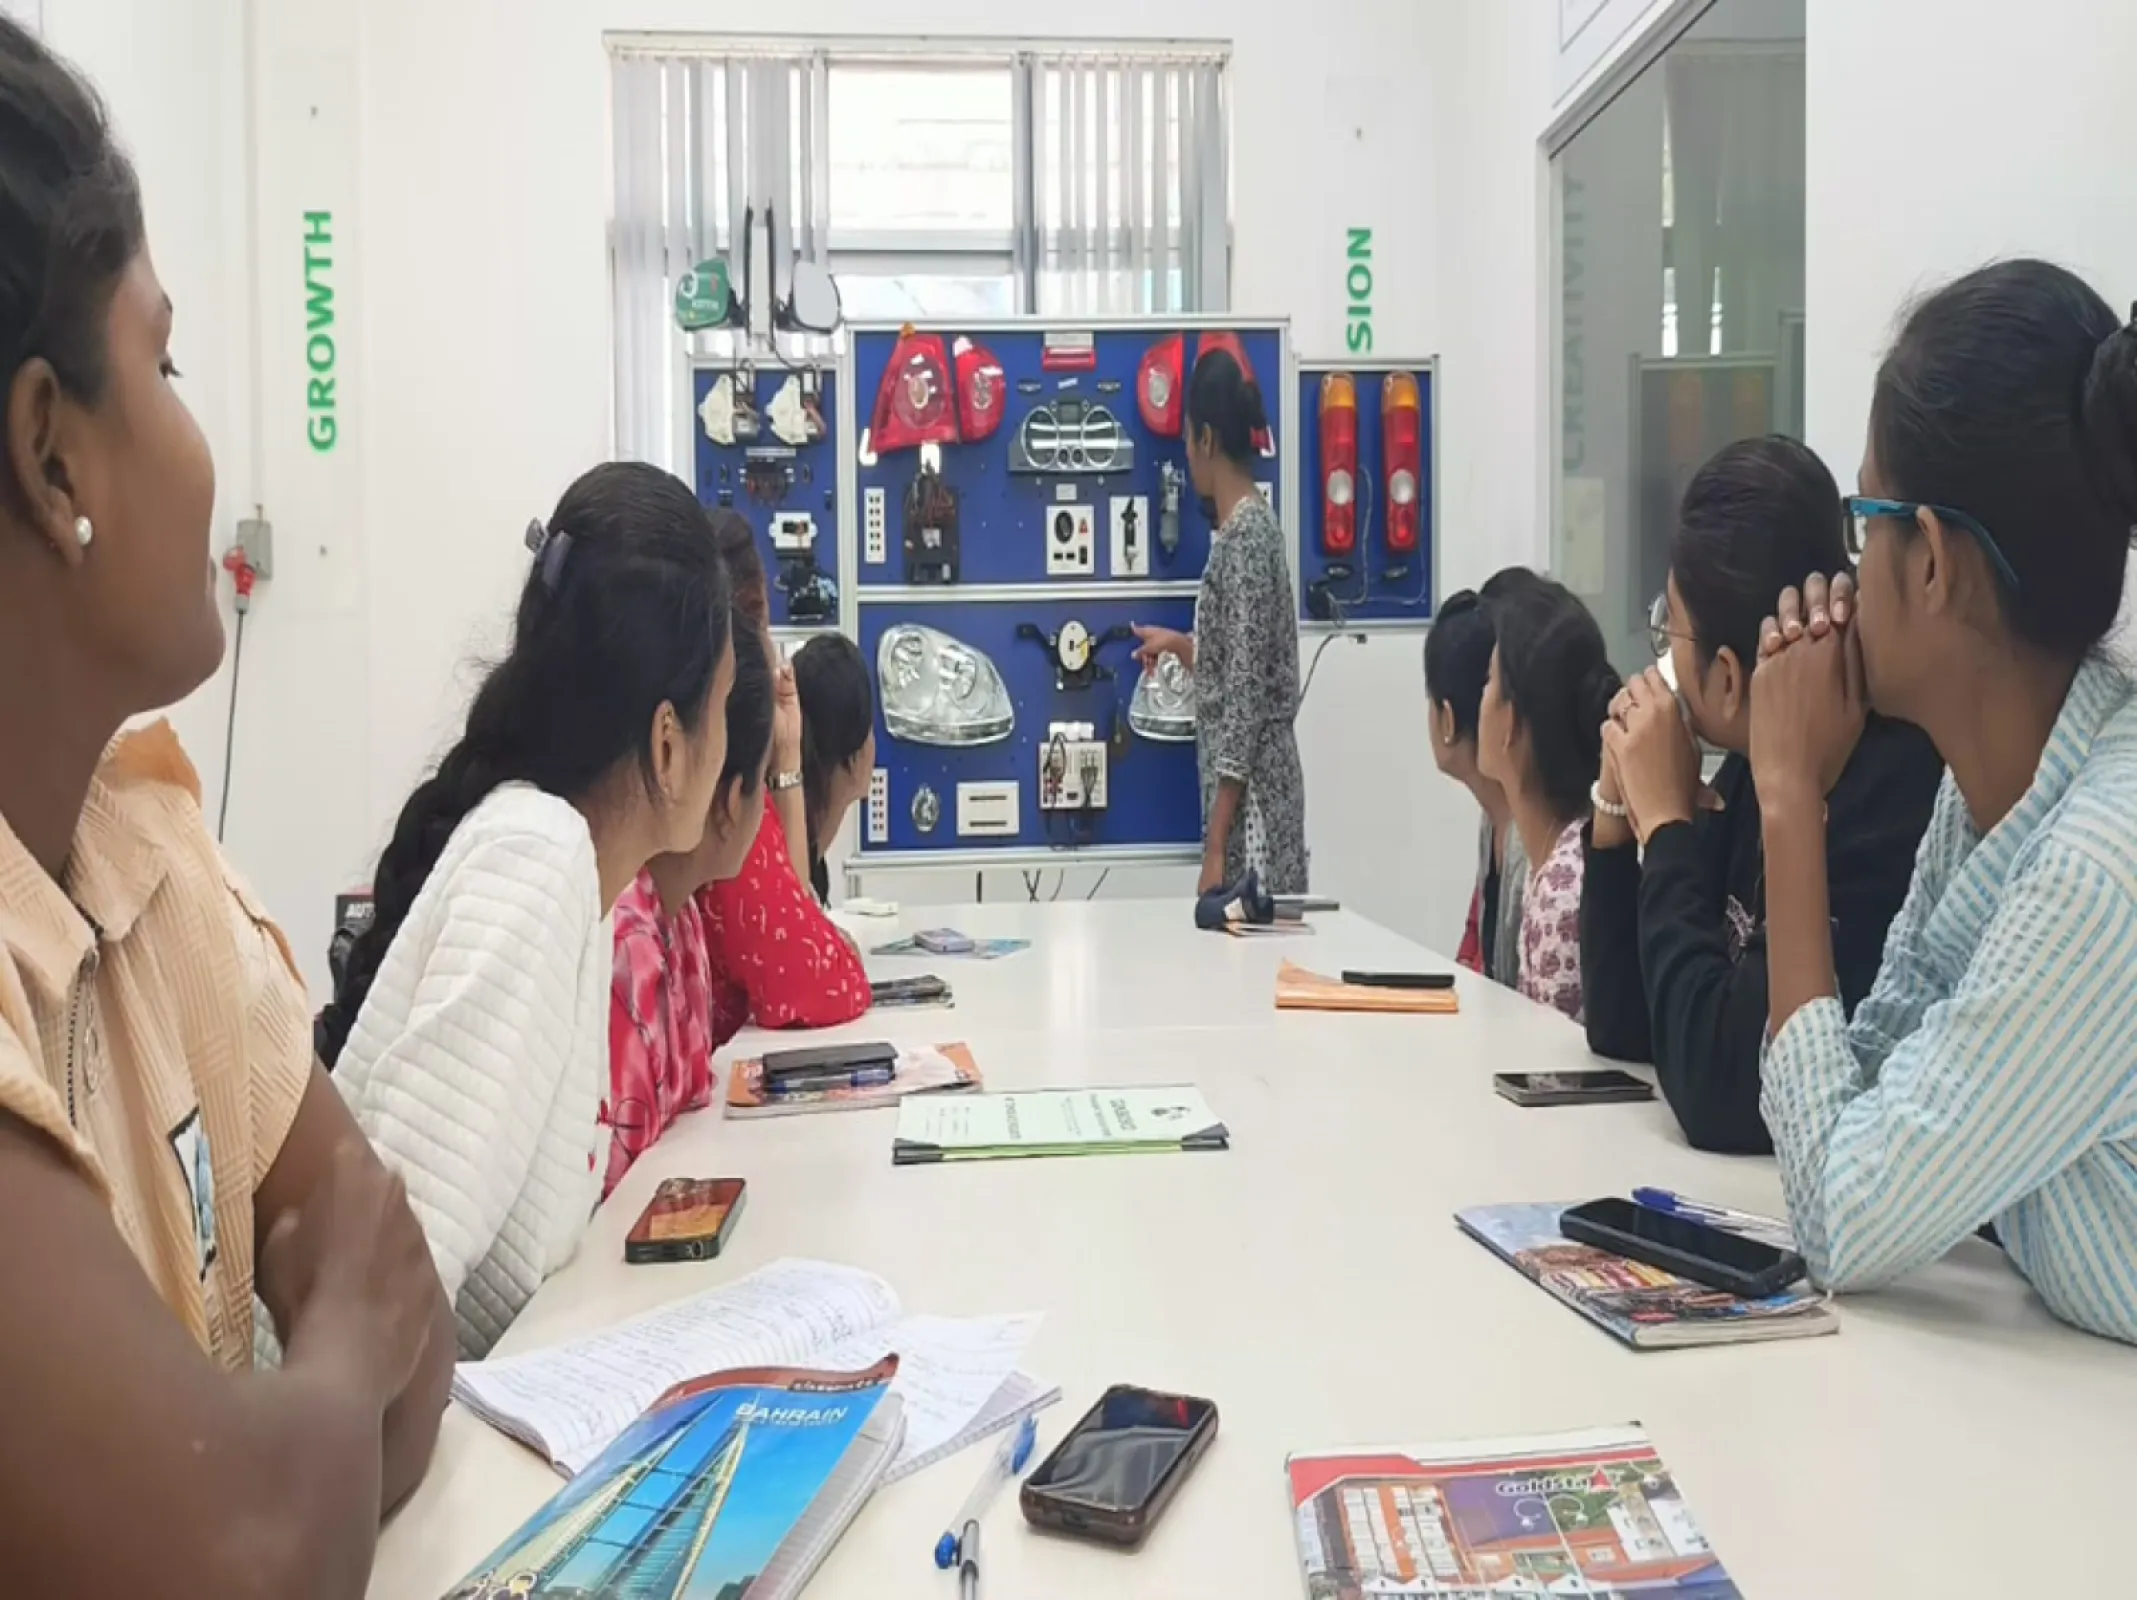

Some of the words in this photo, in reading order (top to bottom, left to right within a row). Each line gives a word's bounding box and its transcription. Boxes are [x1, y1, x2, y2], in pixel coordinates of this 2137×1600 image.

[302, 210, 336, 452] GROWTH
[1346, 227, 1373, 353] SION
[737, 1401, 847, 1422] BAHRAIN
